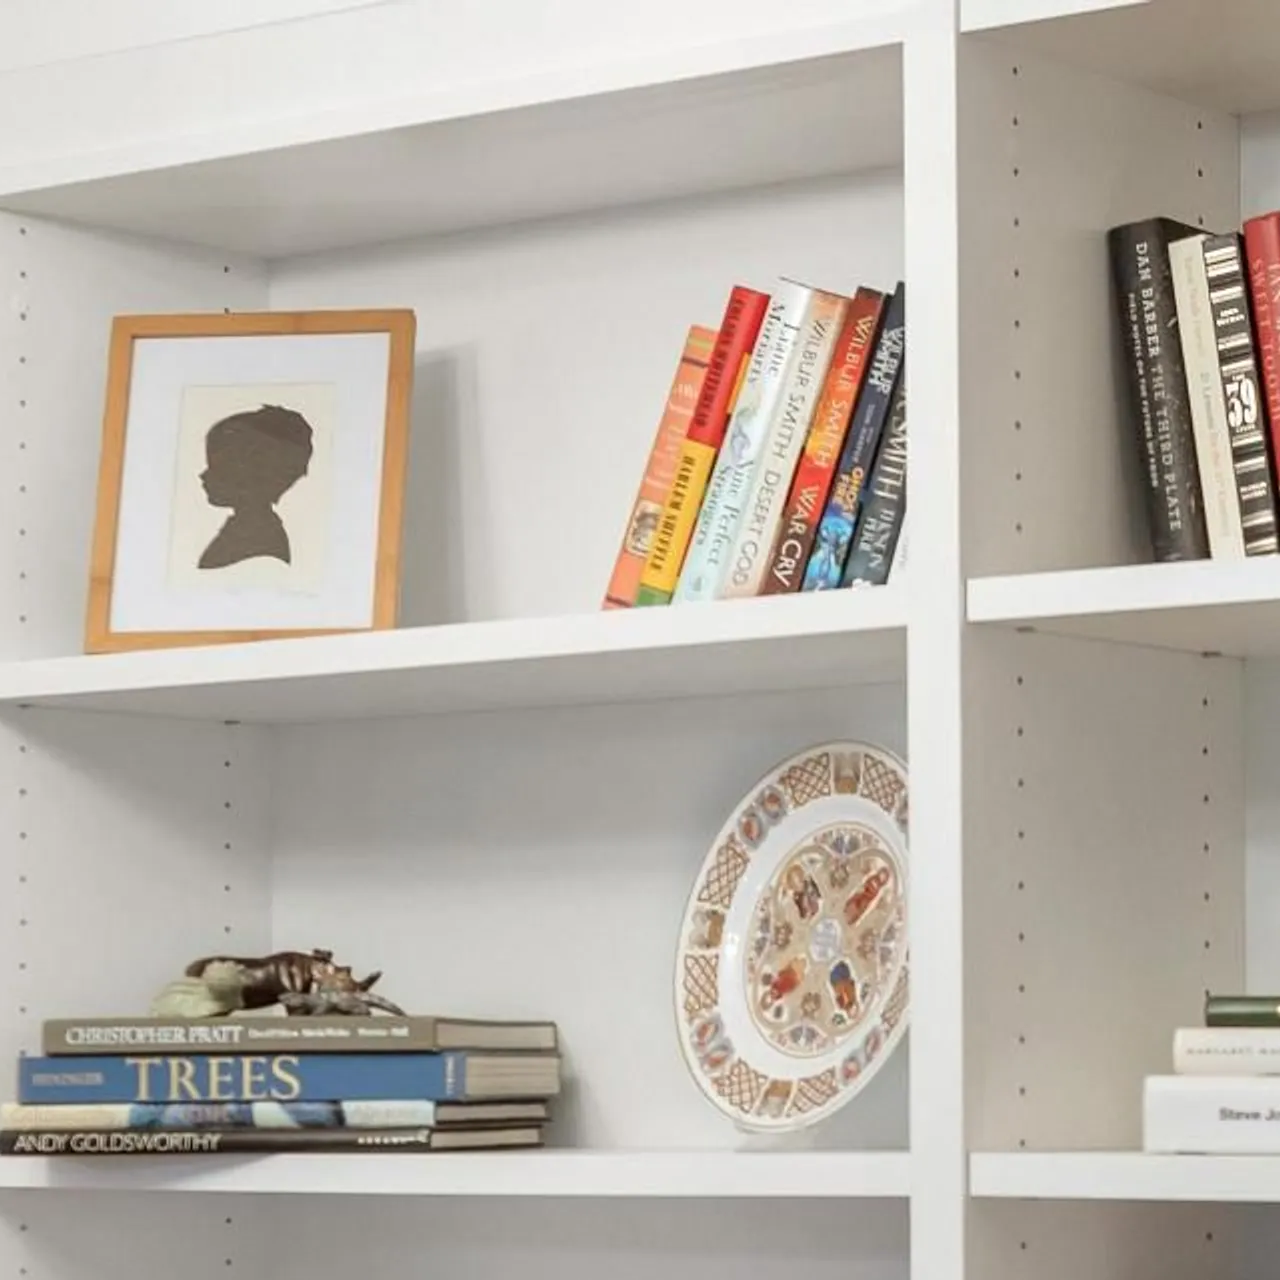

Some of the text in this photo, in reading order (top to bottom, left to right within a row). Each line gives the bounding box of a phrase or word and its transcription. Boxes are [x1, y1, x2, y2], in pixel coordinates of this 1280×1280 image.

[1251, 257, 1269, 333] SWEET
[769, 322, 800, 380] Liane
[867, 329, 896, 387] SMITH
[880, 325, 905, 395] WILBUR
[1135, 242, 1181, 532] DAN BARBER THE THIRD PLATE
[1226, 378, 1258, 428] 39
[732, 319, 829, 587] WILBUR SMITH DESERT GOD
[773, 315, 874, 587] WILBUR SMITH WAR CRY
[672, 456, 697, 512] HARLEM
[706, 458, 755, 565] Nine Perfect
[840, 466, 865, 520] GHOST
[65, 1026, 187, 1045] CHRISTOPHER
[189, 1026, 244, 1043] PRATT
[125, 1054, 302, 1101] TREES
[14, 1132, 222, 1152] ANDY GOLDSWORTHY
[1219, 1107, 1261, 1122] Steve
